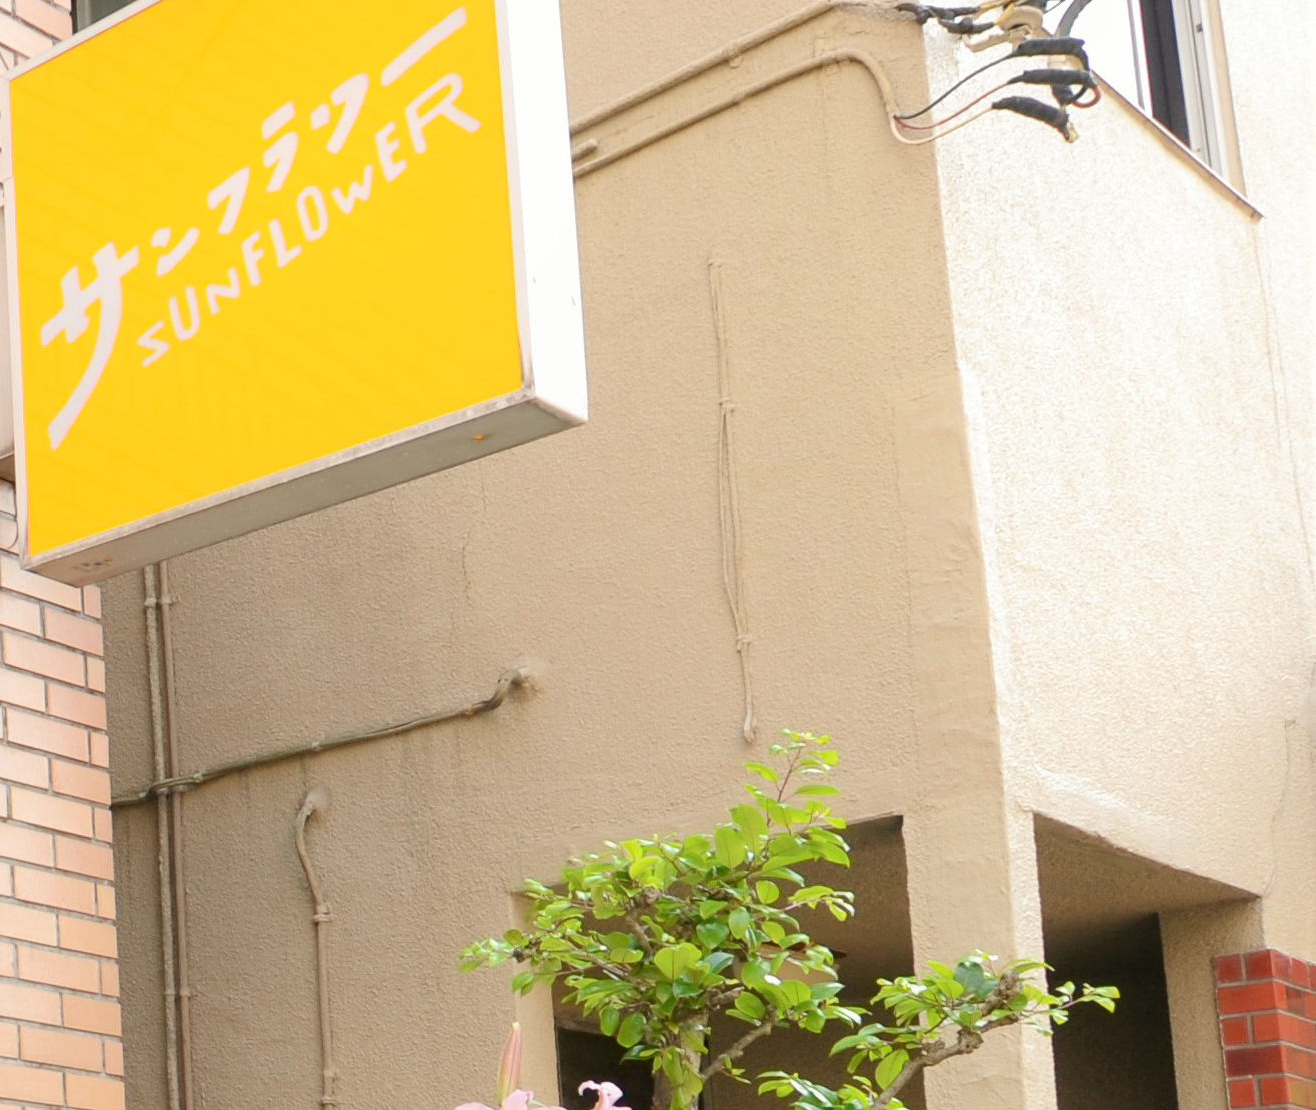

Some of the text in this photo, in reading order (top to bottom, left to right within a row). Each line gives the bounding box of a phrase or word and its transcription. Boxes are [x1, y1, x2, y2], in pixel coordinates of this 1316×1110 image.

[40, 6, 467, 450] サンフラワー
